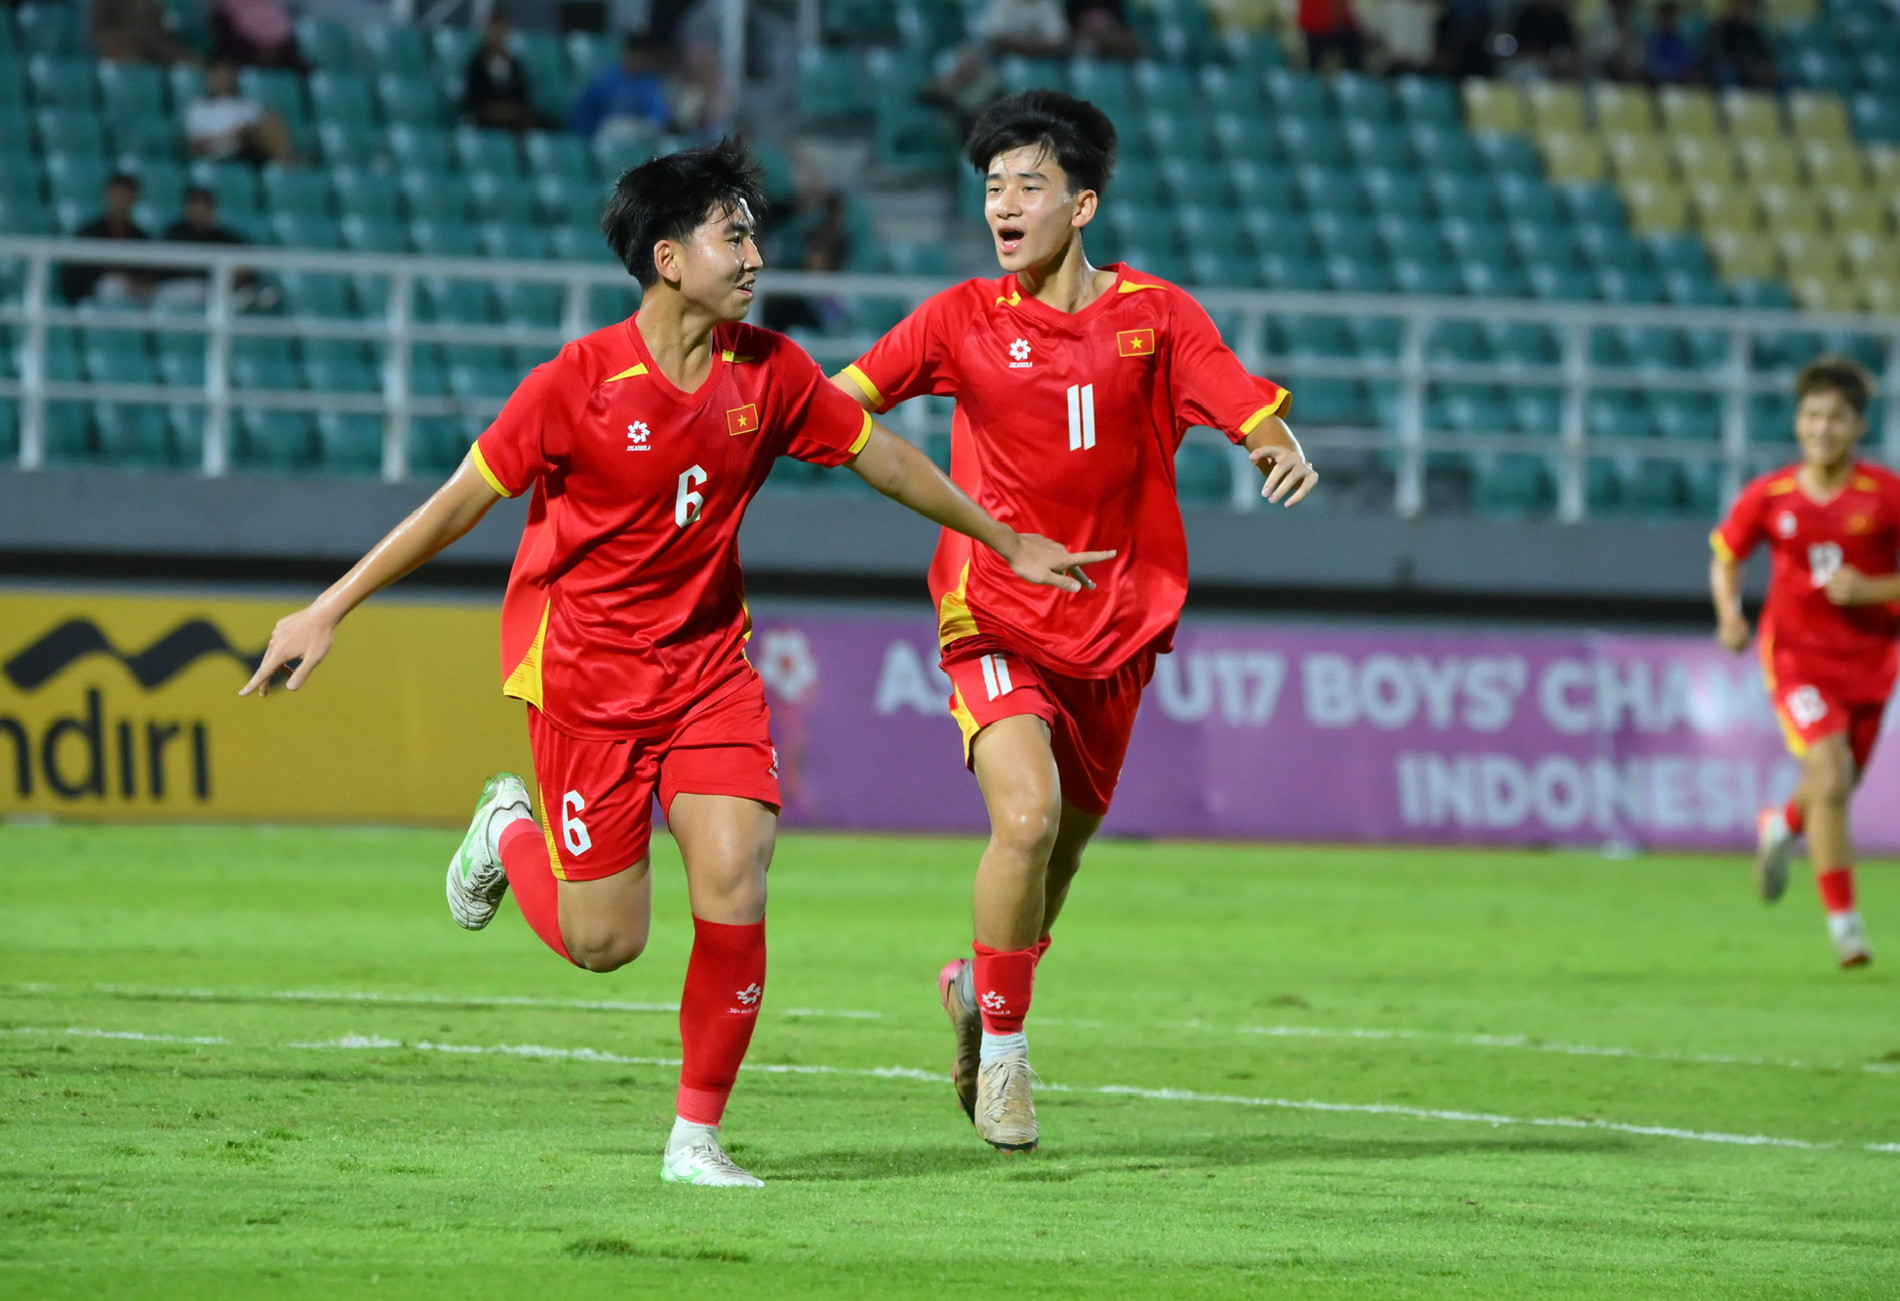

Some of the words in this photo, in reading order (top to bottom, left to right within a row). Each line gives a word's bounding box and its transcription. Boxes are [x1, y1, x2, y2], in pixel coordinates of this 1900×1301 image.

[1067, 383, 1096, 452] 11
[675, 464, 708, 529] 6
[980, 654, 1013, 702] 11
[1158, 650, 1287, 727] U17
[562, 790, 592, 857] 6
